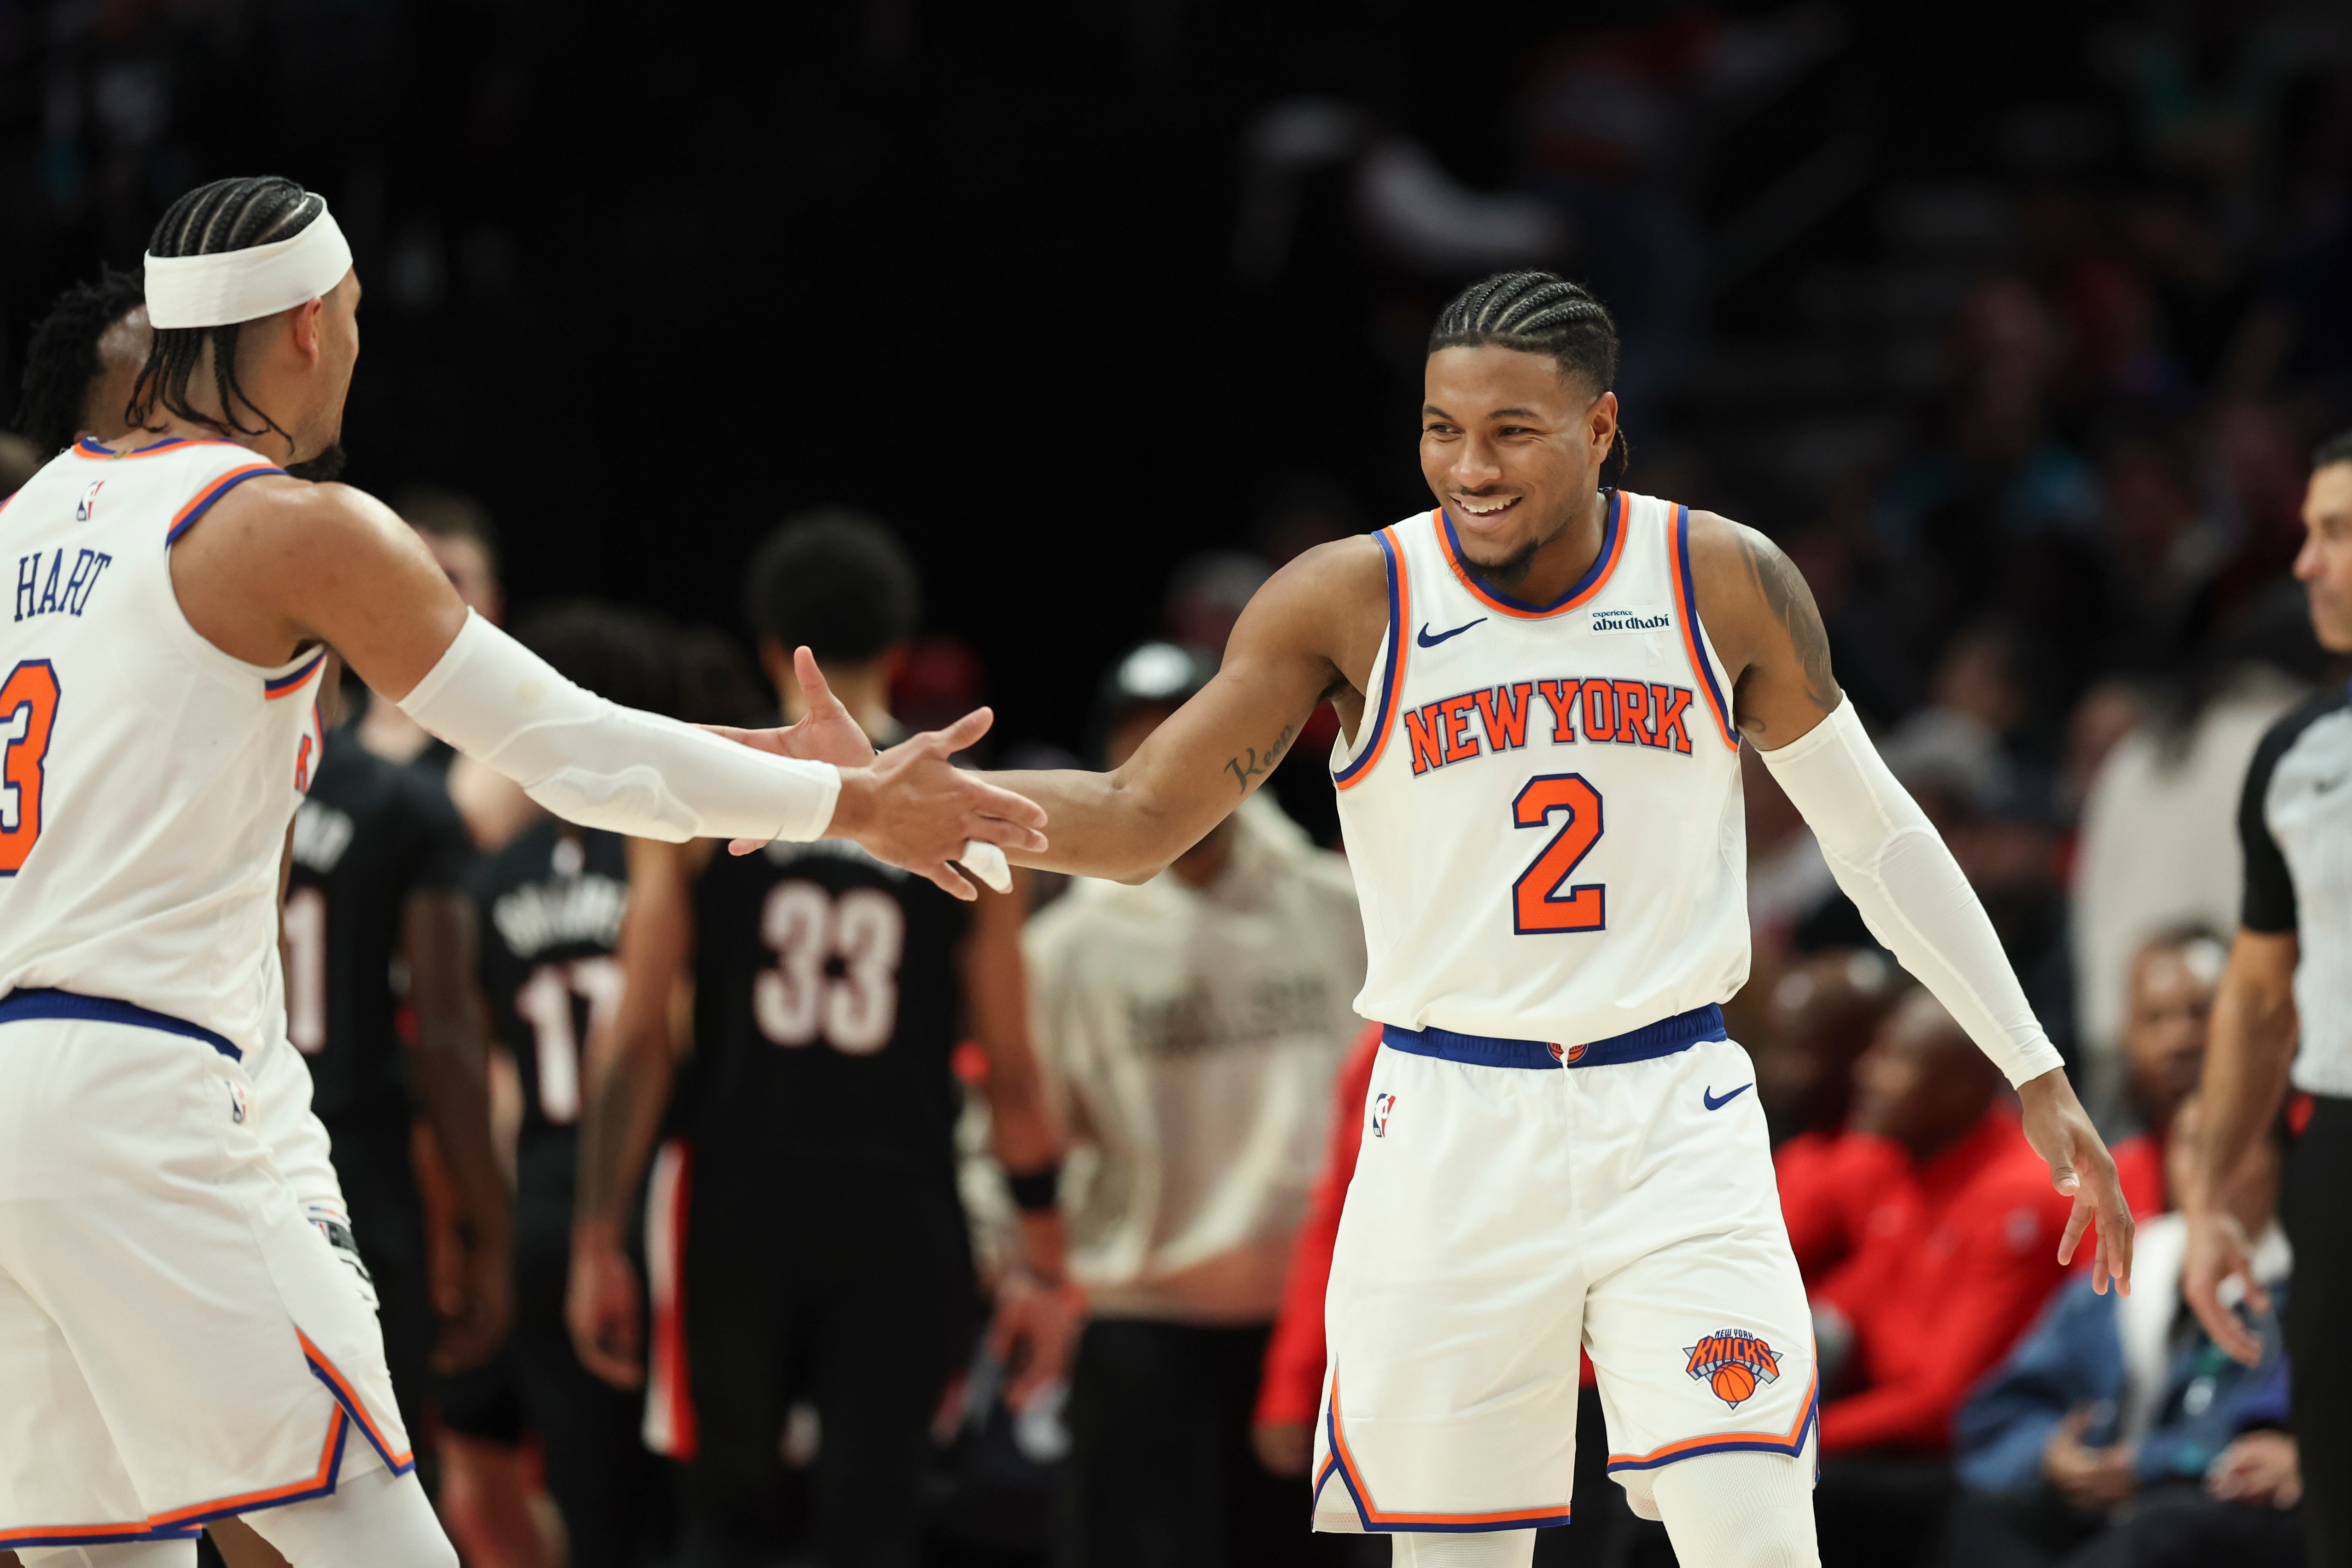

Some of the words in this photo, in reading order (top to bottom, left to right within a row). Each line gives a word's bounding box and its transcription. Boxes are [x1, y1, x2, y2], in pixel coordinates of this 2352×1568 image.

[14, 548, 112, 623] HART
[1593, 618, 1623, 631] abu
[0, 659, 61, 876] 3
[1403, 679, 1535, 778] NEW
[1536, 677, 1694, 757] YORK
[1512, 772, 1606, 935] 2
[753, 877, 906, 1055] 33
[1686, 1335, 1780, 1378] KNICKS
[1714, 1329, 1732, 1338] NEW
[1734, 1329, 1754, 1340] YORK
